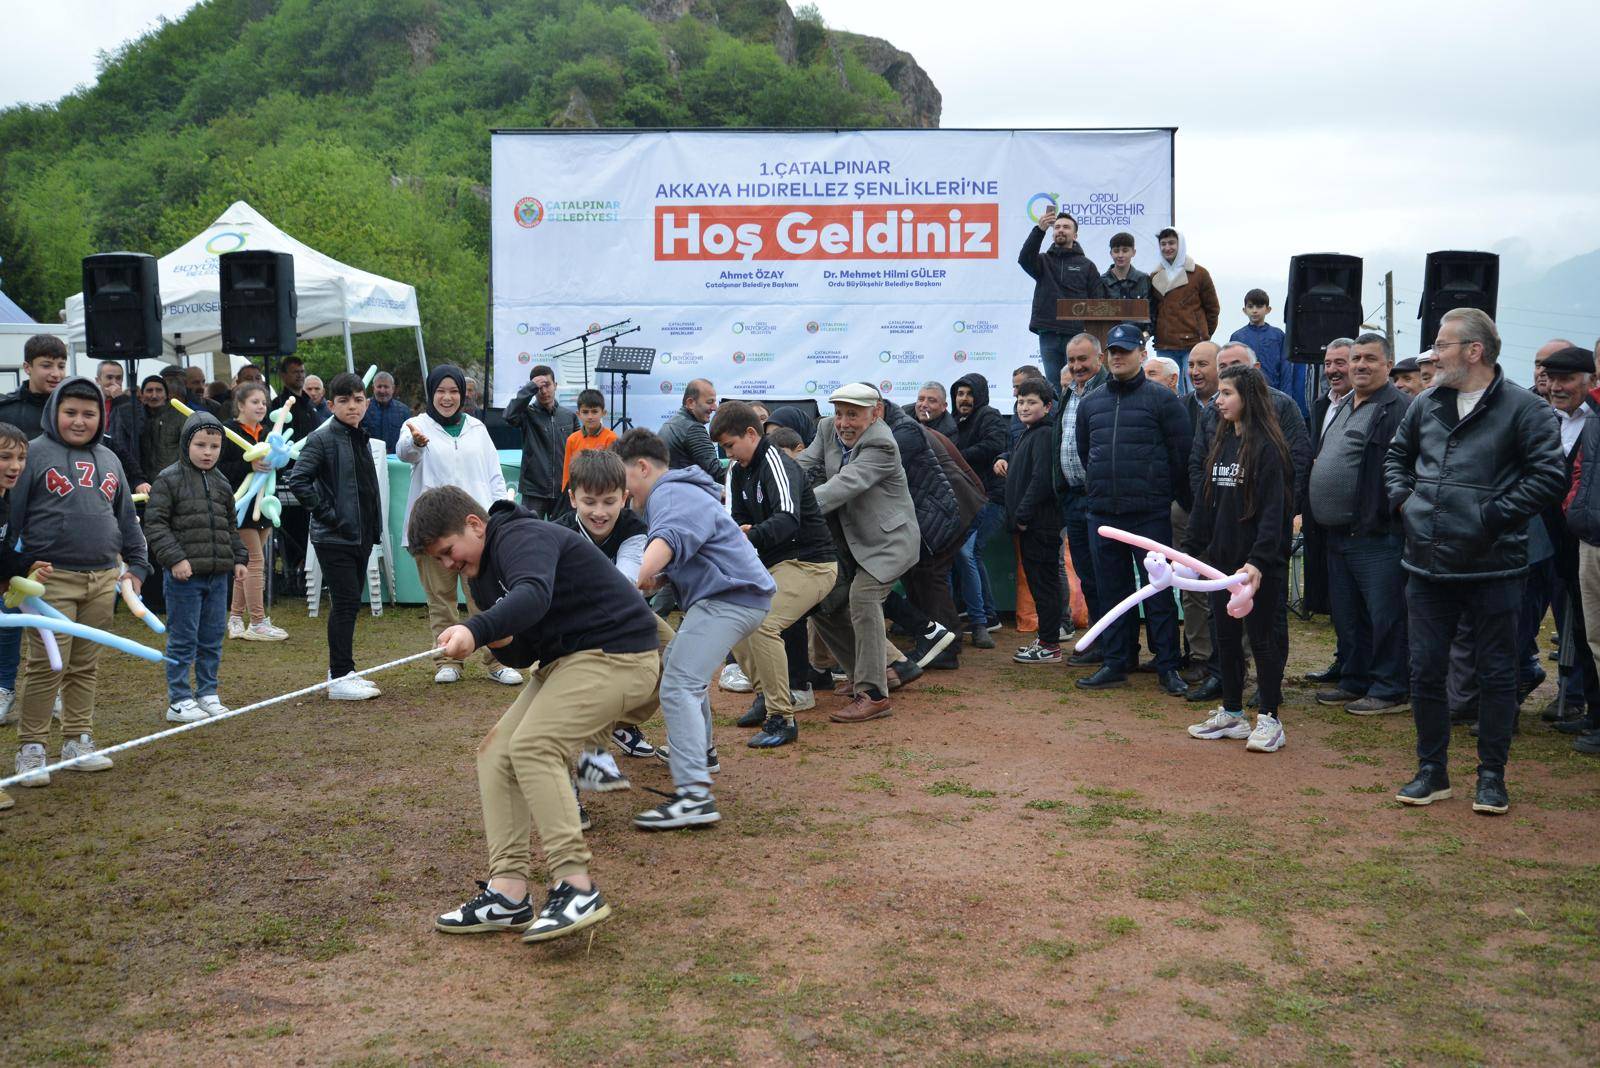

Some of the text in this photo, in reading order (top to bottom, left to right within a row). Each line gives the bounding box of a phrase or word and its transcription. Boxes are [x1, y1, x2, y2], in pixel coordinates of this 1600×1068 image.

[655, 178, 999, 199] AKKAYA HIDIRELLEZ ŞENLİKLERİ'NE
[1090, 193, 1119, 203] ORDU
[1062, 203, 1145, 216] BÜYÜKŞEHİR
[1077, 216, 1131, 225] BELEDİYESİ
[662, 208, 992, 261] Hoş Geldiniz
[720, 268, 785, 280] Ahmet ÖZAY
[823, 267, 947, 279] Dr. Mehmet Hilmi GÜLER
[828, 280, 845, 288] Ordu
